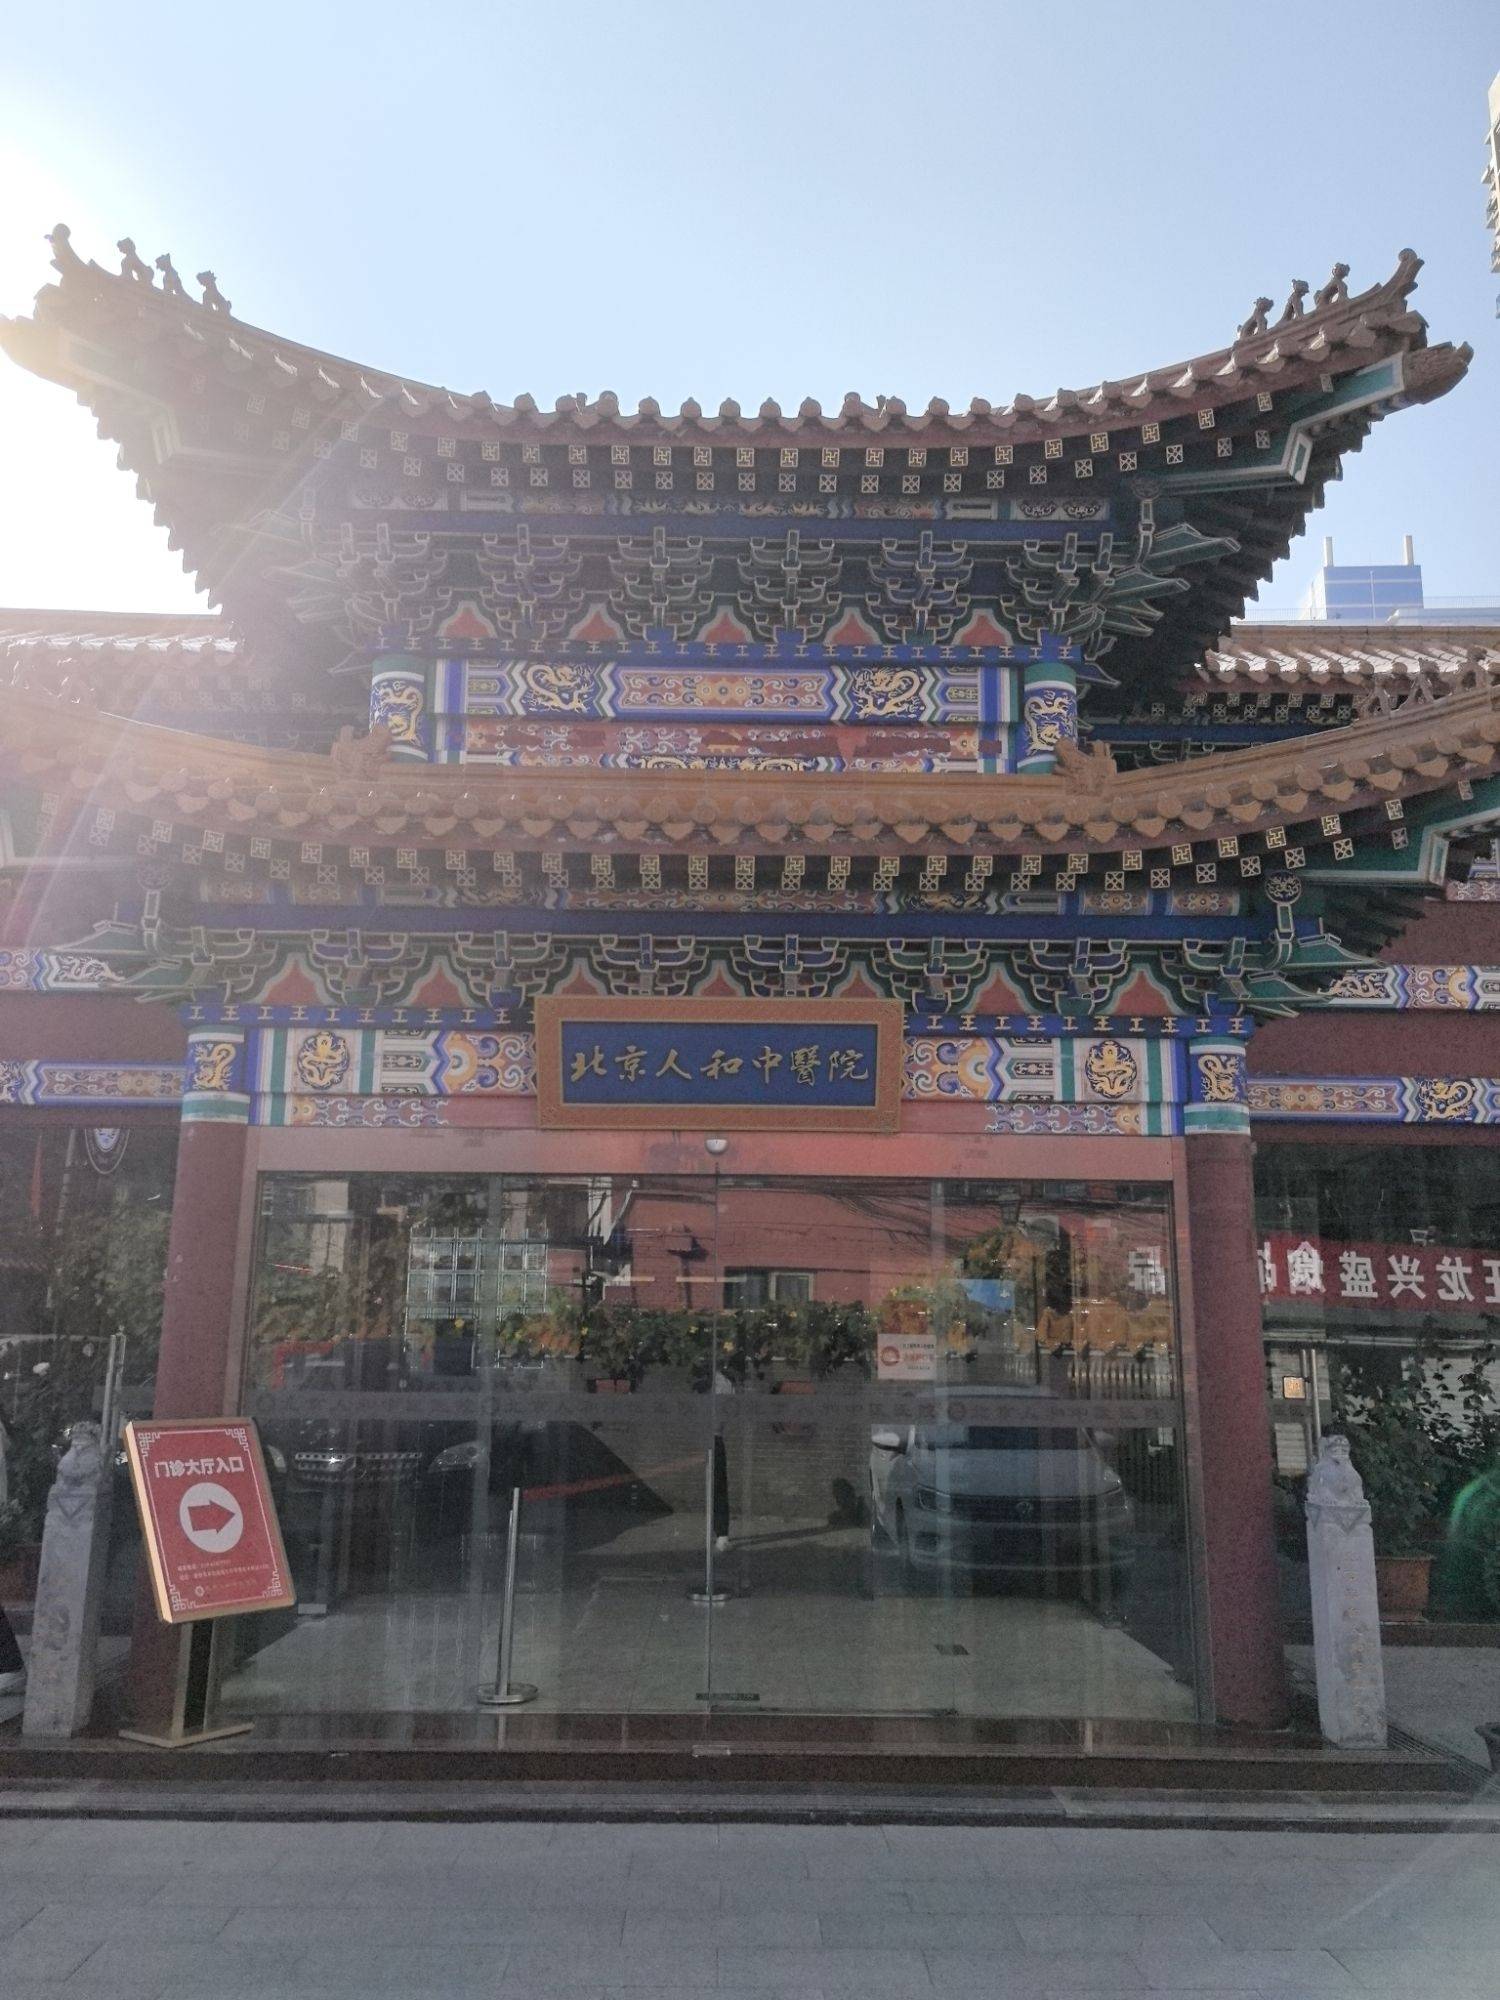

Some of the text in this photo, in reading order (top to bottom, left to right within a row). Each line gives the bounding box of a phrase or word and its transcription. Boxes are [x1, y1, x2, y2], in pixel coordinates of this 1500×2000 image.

[570, 1045, 870, 1087] 北京人和中醫院
[154, 1456, 245, 1478] 门诊大厅入口
